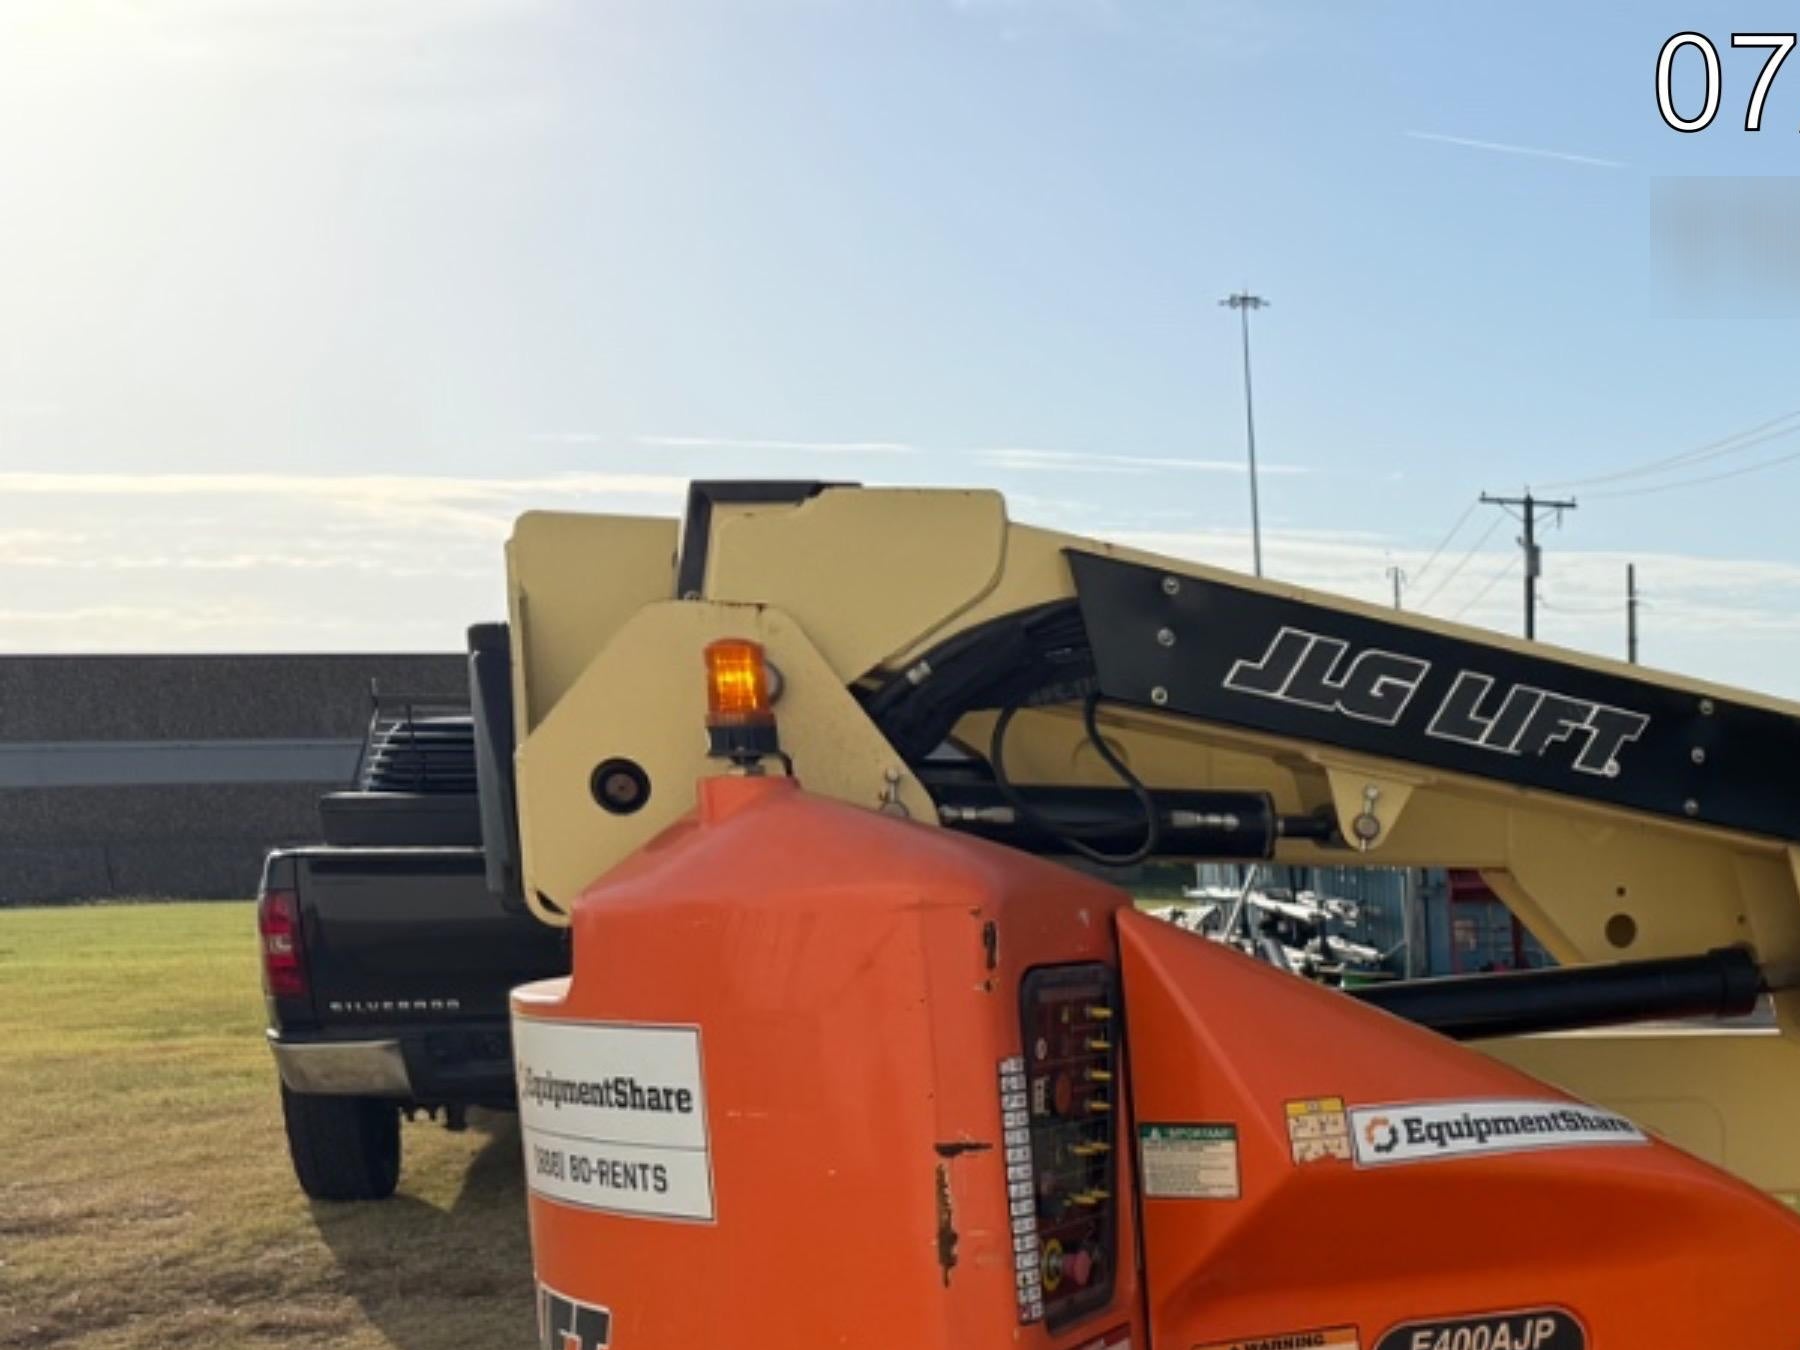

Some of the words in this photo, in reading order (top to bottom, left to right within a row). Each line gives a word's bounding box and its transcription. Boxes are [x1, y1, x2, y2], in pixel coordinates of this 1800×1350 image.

[1223, 625, 1432, 727] JLG
[1425, 669, 1651, 779] LIFT
[1402, 1108, 1637, 1148] EquipmentShare
[569, 1154, 668, 1194] 80-RENTS
